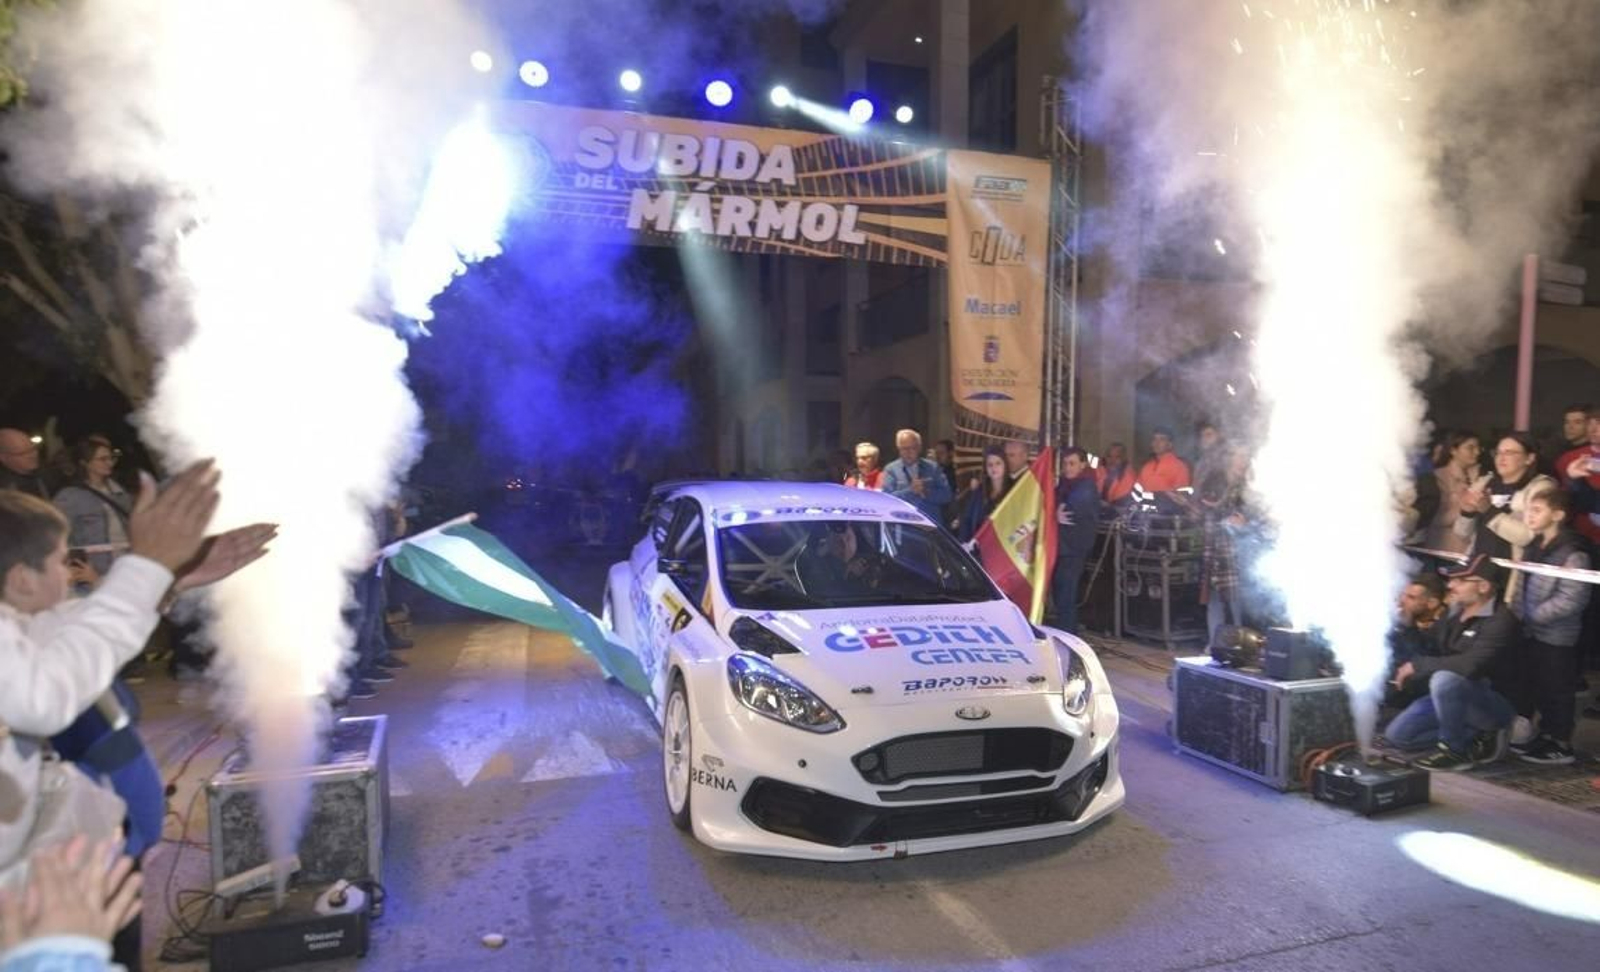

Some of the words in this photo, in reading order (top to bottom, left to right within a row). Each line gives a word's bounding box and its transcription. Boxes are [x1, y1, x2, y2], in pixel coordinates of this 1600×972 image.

[574, 125, 797, 186] SUBIDA
[574, 171, 618, 191] DEL
[626, 180, 866, 245] MÁRMOL
[964, 297, 1021, 316] Macael
